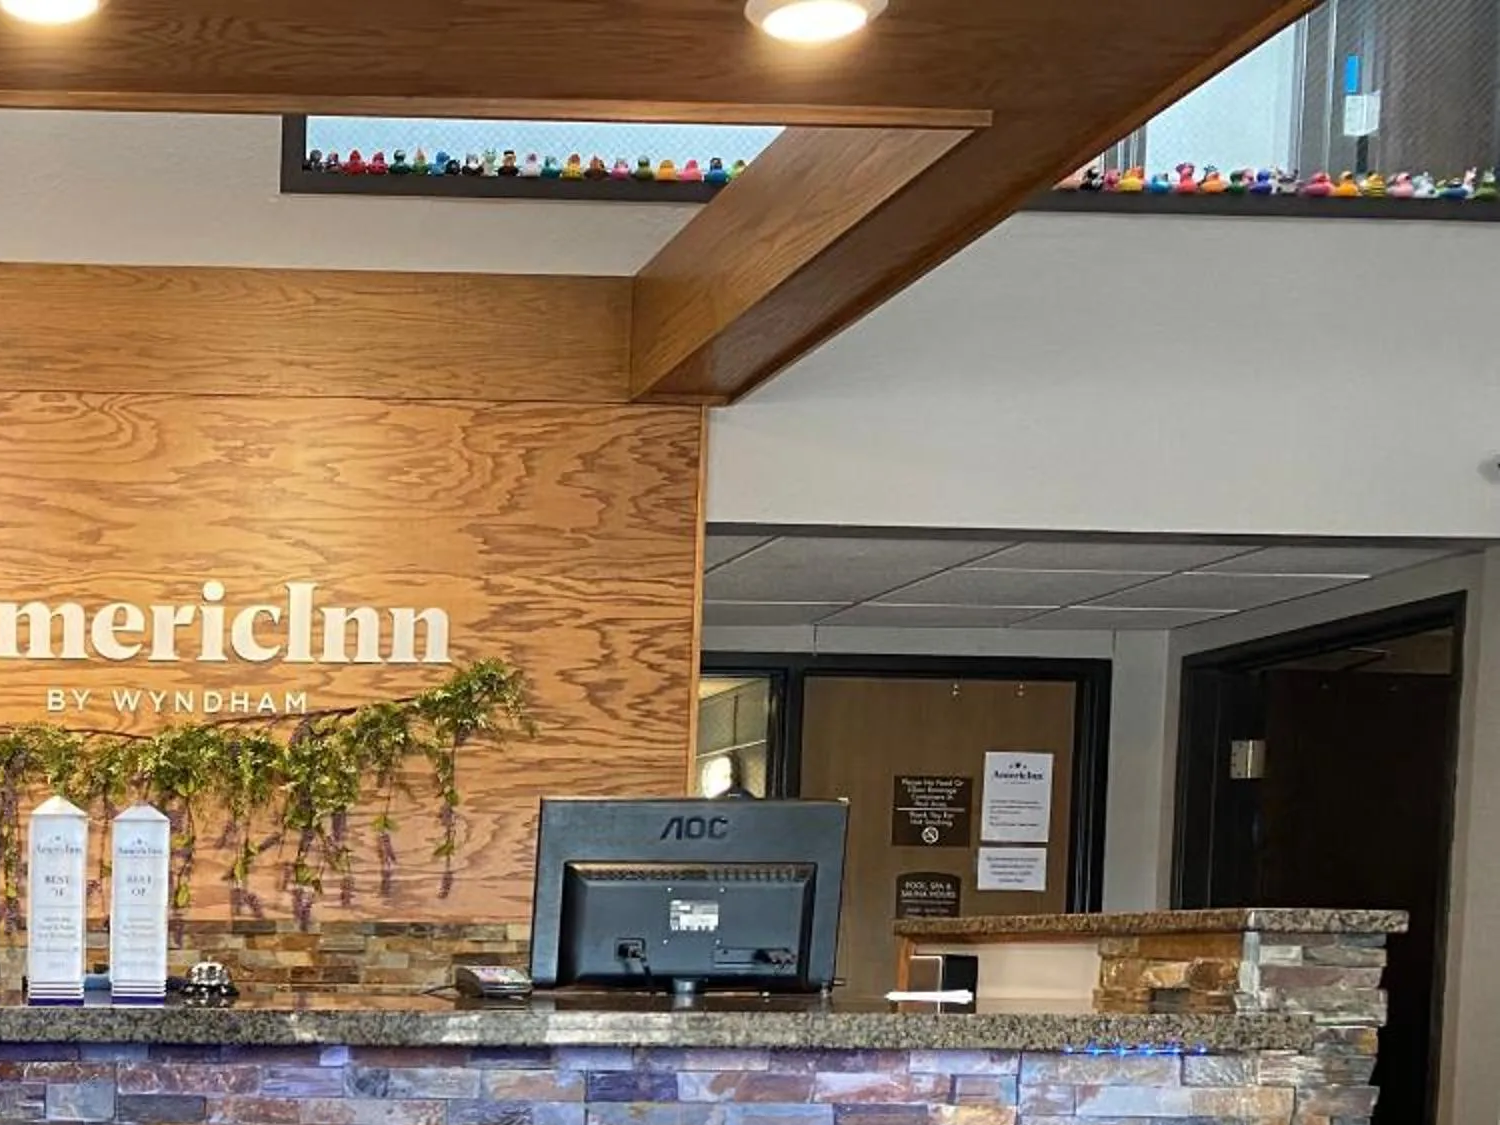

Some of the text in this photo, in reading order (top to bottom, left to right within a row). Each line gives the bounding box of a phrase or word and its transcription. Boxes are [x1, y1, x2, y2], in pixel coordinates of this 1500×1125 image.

[46, 689, 308, 713] BY WYNDHAM
[660, 816, 729, 841] AOC
